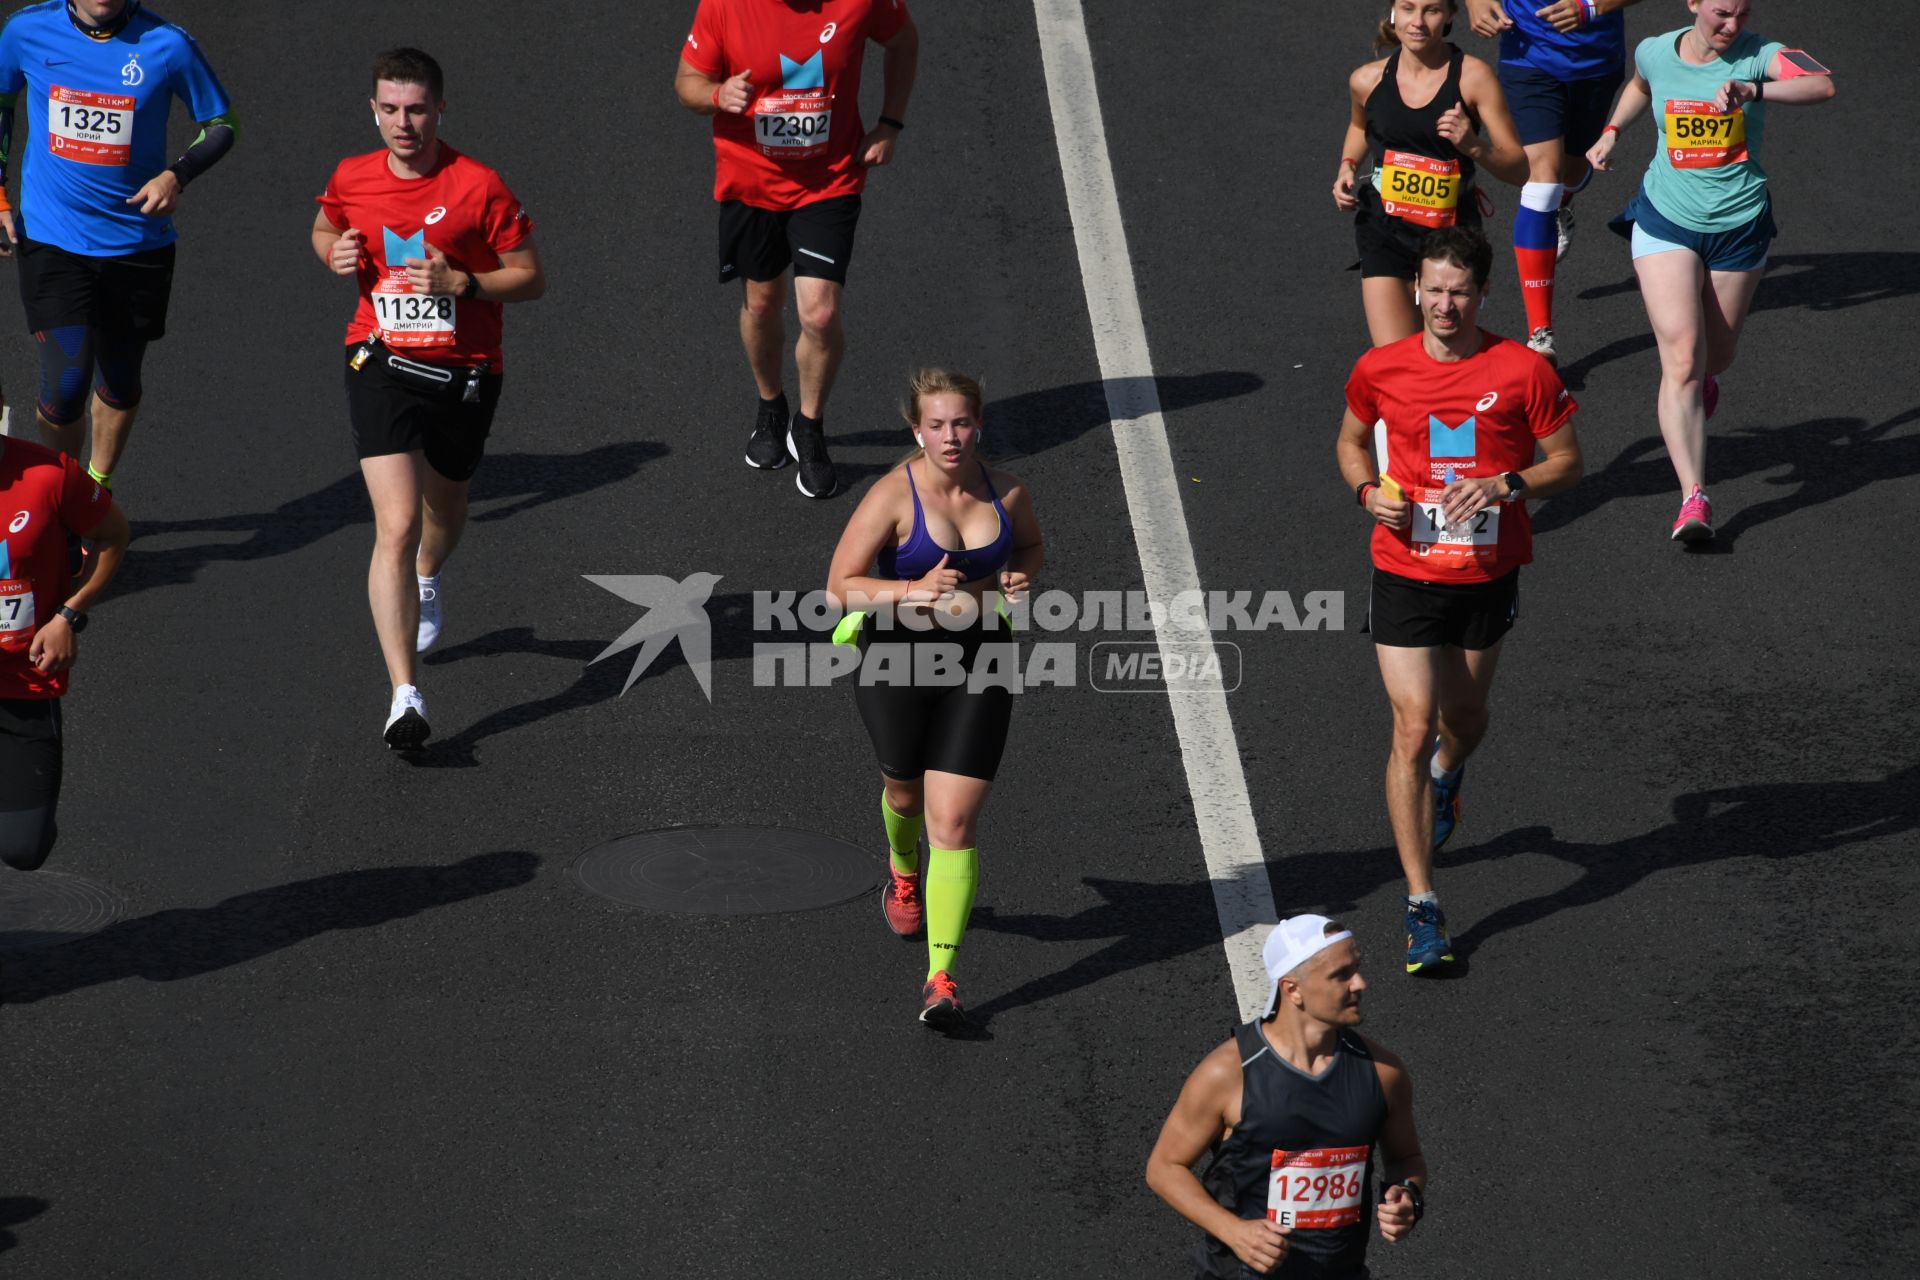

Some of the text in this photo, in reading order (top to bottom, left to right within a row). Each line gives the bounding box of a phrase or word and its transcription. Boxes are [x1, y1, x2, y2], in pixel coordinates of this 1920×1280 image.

[61, 106, 121, 134] 1325
[760, 115, 828, 137] 12302
[1676, 117, 1734, 138] 5897
[55, 136, 64, 149] D
[76, 131, 101, 141] ЮРИЙ
[1674, 149, 1684, 161] G
[1392, 171, 1451, 199] 5805
[1402, 195, 1436, 206] НАТАЛЬЯ
[1385, 202, 1395, 214] D
[1525, 280, 1552, 288] РОССИ
[378, 297, 452, 320] 11328
[393, 322, 433, 330] ДМИТРИЙ
[1427, 508, 1489, 534] 12
[1420, 544, 1430, 557] D
[1276, 1170, 1360, 1202] 12986
[1281, 1211, 1291, 1226] E
